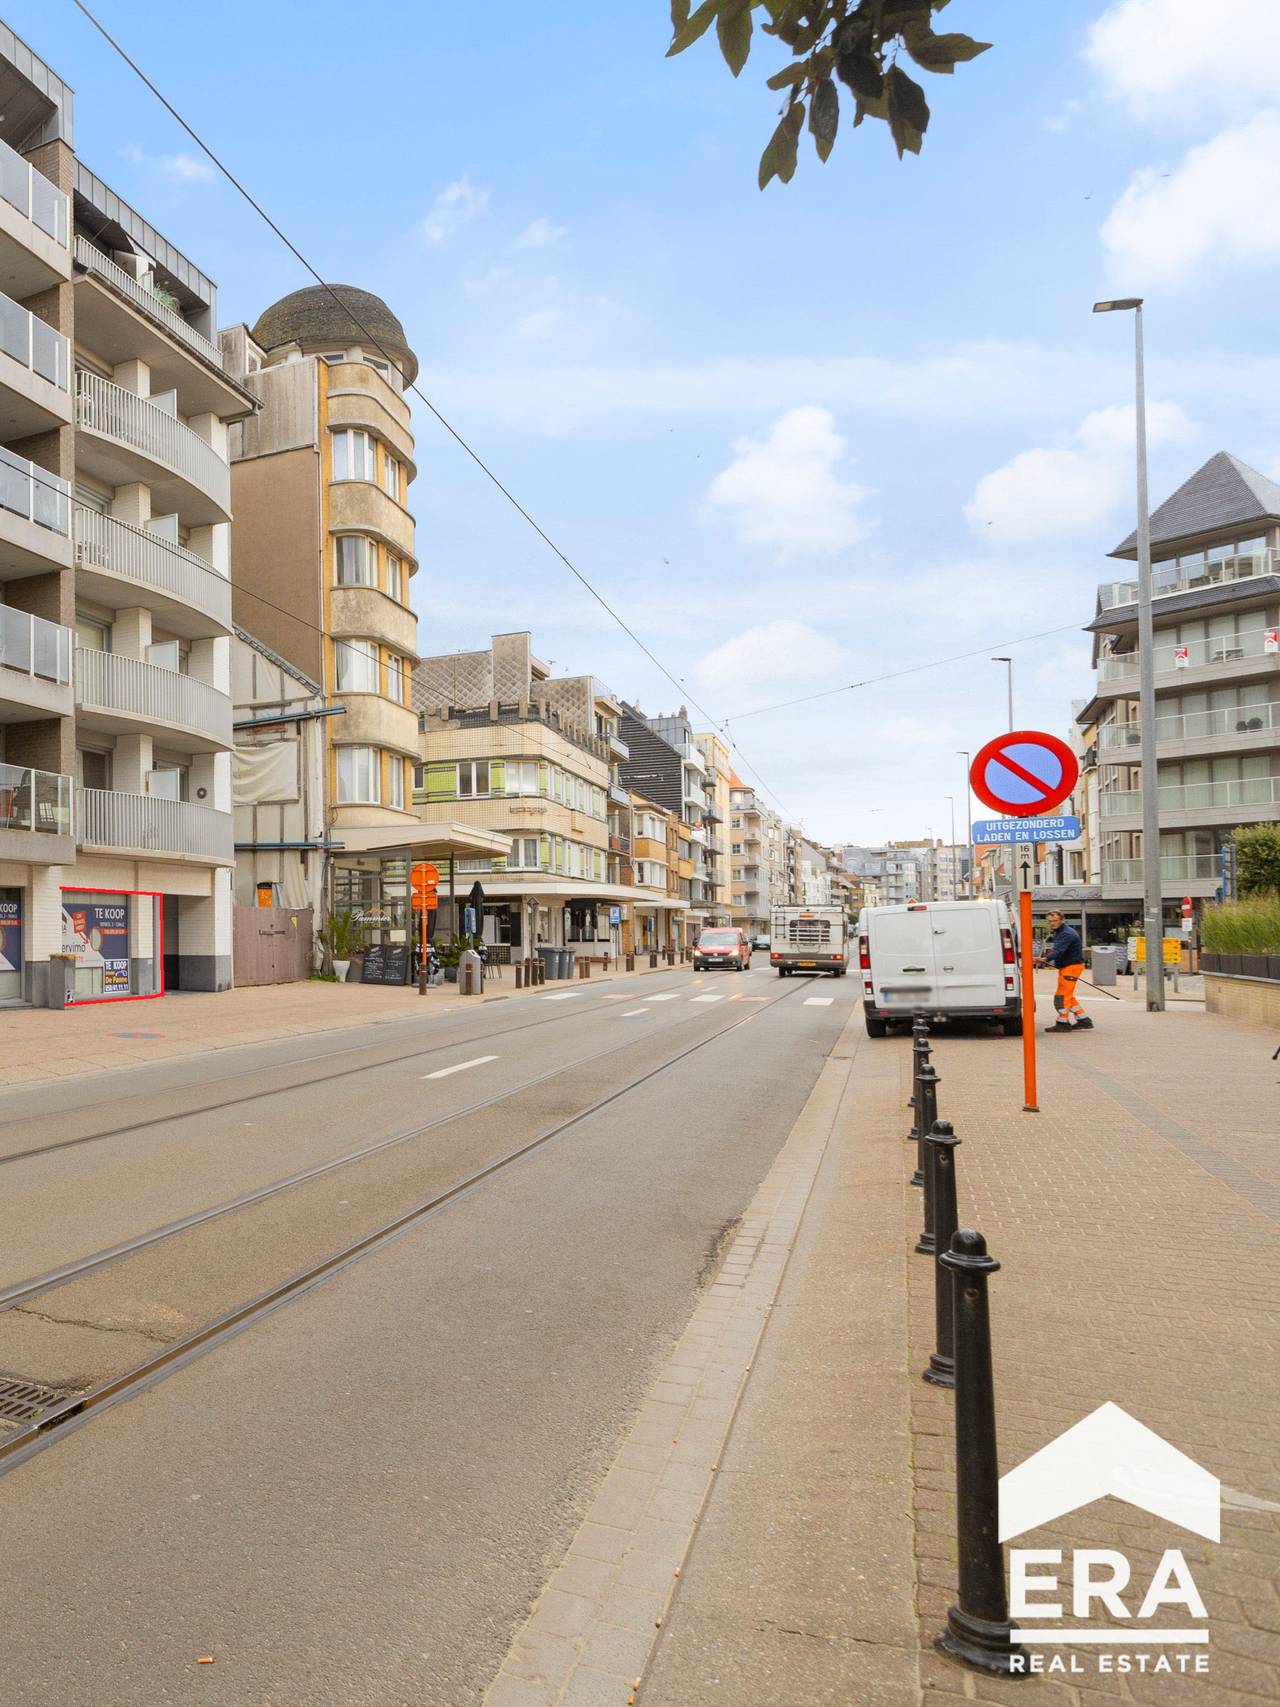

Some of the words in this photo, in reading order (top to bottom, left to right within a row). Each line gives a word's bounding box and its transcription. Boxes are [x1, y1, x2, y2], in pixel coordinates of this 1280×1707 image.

[986, 819, 1064, 831] UITGEZONDERD
[977, 832, 1011, 842] LADEN
[1015, 832, 1029, 841] EN
[1033, 829, 1075, 840] LOSSEN
[1020, 844, 1030, 853] 16
[1020, 852, 1030, 860] m
[94, 908, 103, 919] TE
[104, 908, 125, 919] KOOP
[62, 941, 86, 953] ervimo
[105, 961, 112, 970] TE
[113, 961, 127, 969] KOOP
[105, 976, 112, 984] De
